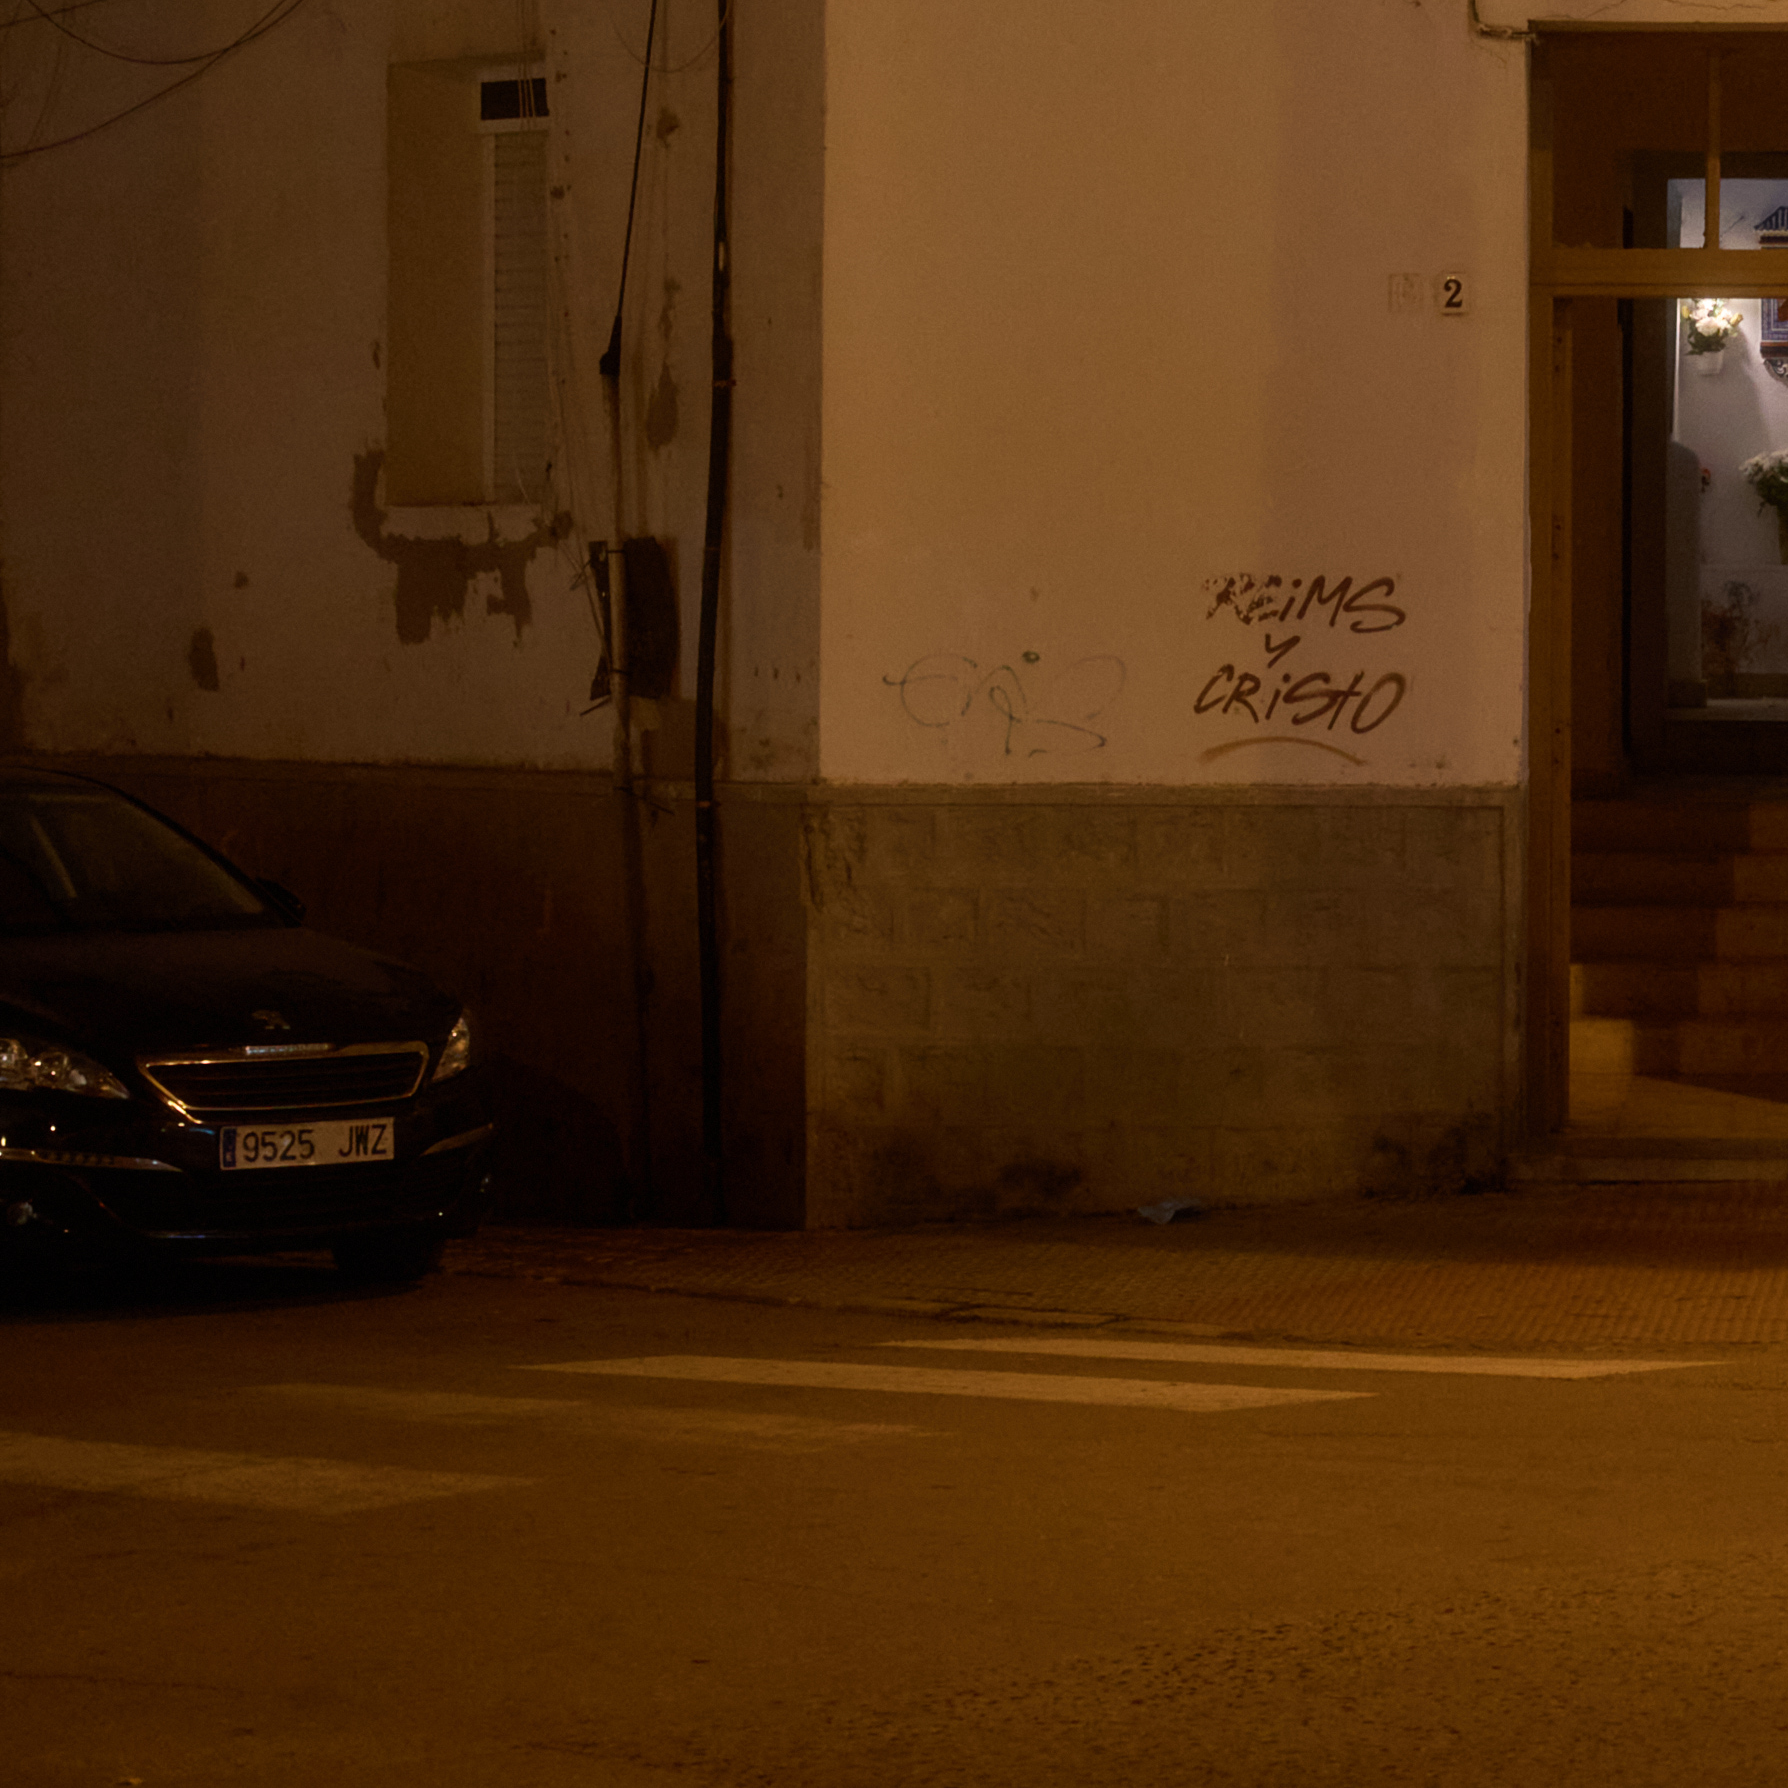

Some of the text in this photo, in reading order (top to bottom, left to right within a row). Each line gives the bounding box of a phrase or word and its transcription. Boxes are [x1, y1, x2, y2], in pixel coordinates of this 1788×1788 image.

[1443, 278, 1463, 309] 2
[242, 1124, 388, 1163] 9525 JWZ
